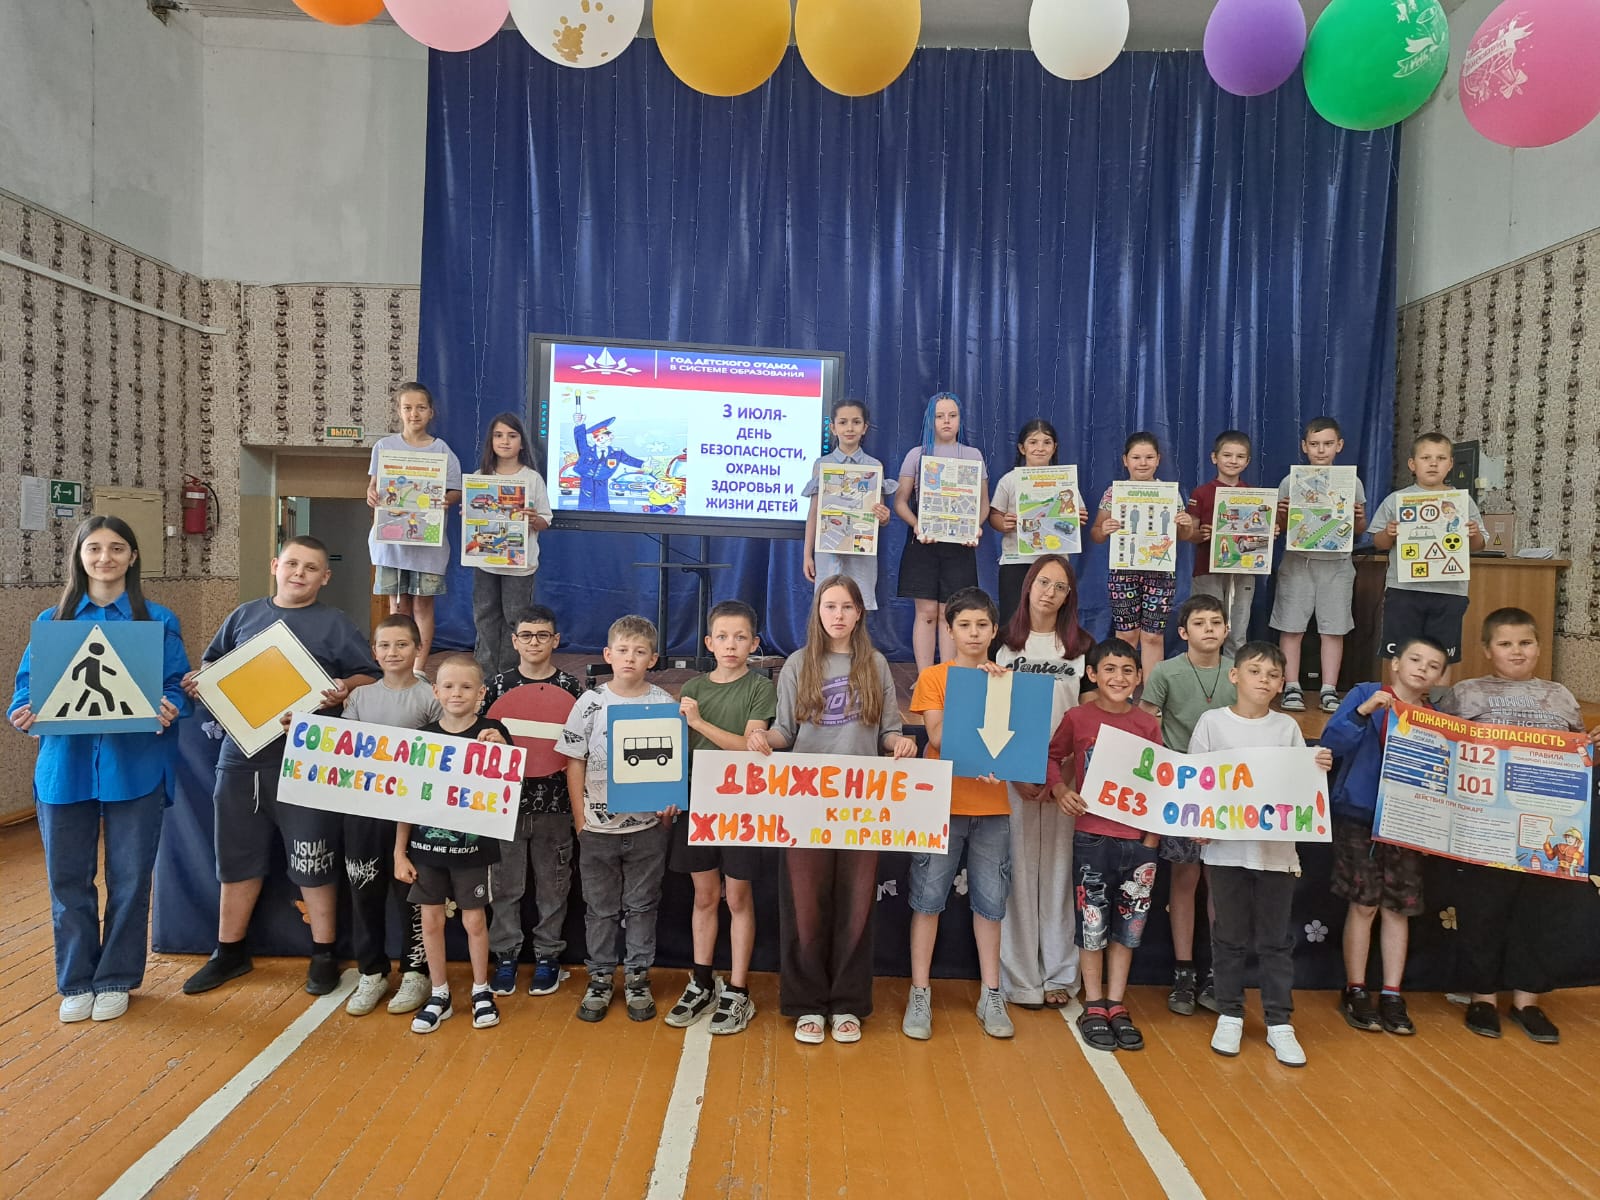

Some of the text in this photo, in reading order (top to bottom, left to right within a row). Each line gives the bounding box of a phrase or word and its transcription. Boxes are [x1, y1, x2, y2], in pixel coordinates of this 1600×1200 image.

[679, 365, 728, 374] СИСТЕМЕ
[729, 368, 805, 378] ОБРАЗОВАНИЯ
[723, 404, 787, 421] 3 ИЮЛЯ-
[330, 428, 358, 438] ВЫХОД
[736, 427, 772, 442] ДЕНЬ
[700, 443, 807, 461] БЕЗОПАСНОСТИ,
[726, 462, 781, 476] ОХРАНЫ
[711, 479, 794, 495] ЗДОРОВЬЯ И
[705, 496, 798, 513] ЖИЗНИ ДЕТЕЙ
[1425, 508, 1436, 517] 70
[1412, 710, 1467, 735] ПОЖАРНАЯ
[1469, 726, 1566, 747] БЕЗОПАСНОСТЬ
[462, 742, 522, 782] ПДД
[1459, 743, 1495, 765] 112
[1529, 751, 1564, 760] ПРАВИЛА
[1132, 747, 1254, 791] ДОРОГА
[282, 758, 511, 815] НЕ ОКАЖЕТЕСЬ В БЕДЕ!
[1457, 773, 1494, 796] 101
[1098, 780, 1326, 835] БЕЗ ОПАСНОСТИ!
[689, 807, 891, 847] ЖИЗНЬ, КОГДА
[809, 823, 949, 849] ПО ПРАВИЛАМ!
[293, 839, 328, 857] USUAL
[290, 851, 335, 876] SUSPECT
